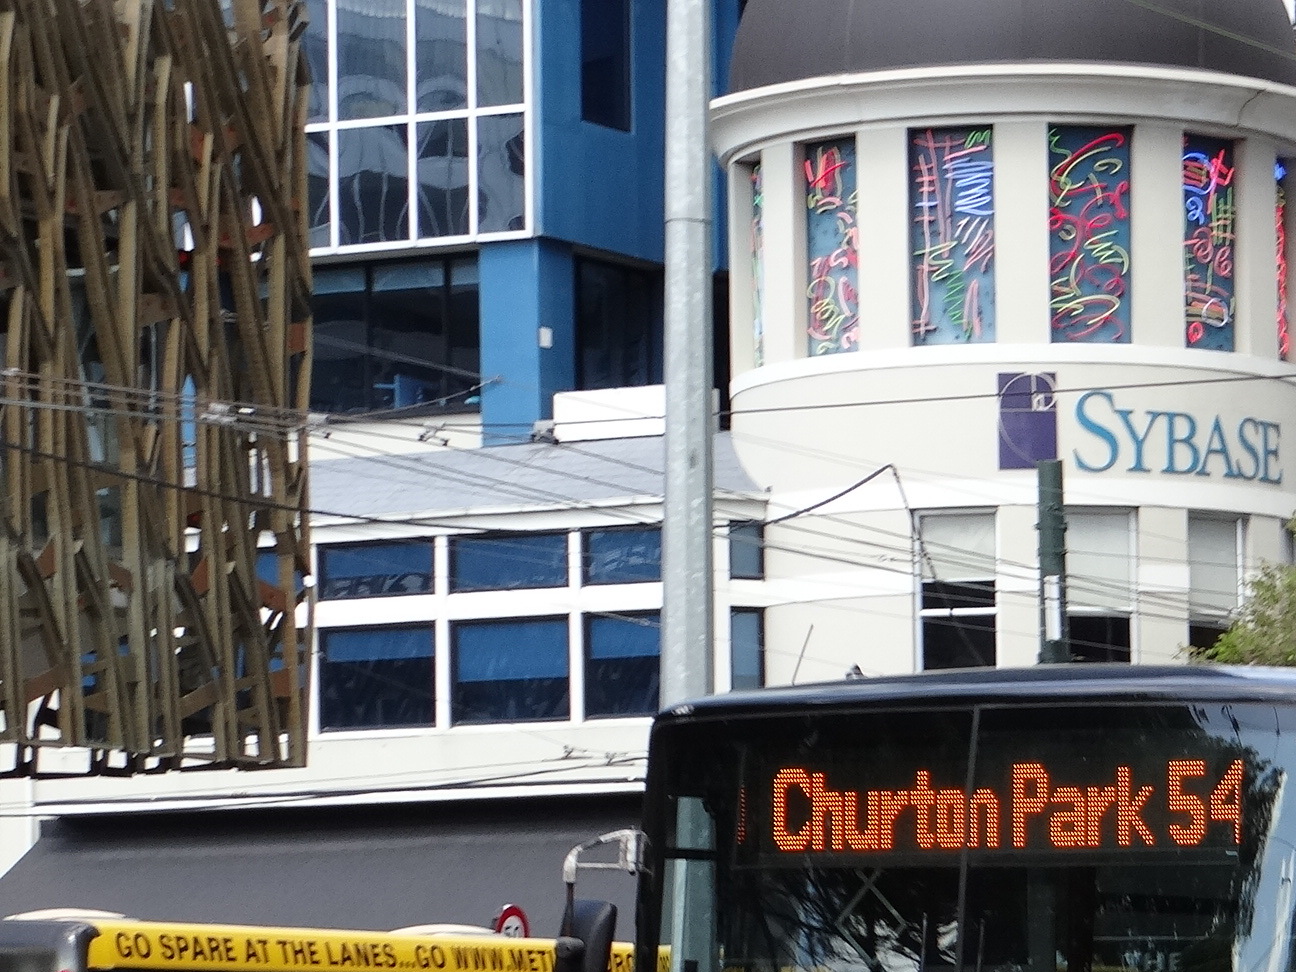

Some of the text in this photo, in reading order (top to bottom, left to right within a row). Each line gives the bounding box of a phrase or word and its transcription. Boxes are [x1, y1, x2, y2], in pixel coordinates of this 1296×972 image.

[1072, 388, 1283, 485] SYBASE
[772, 758, 1244, 851] Churton Park 54
[115, 932, 151, 960] GO
[158, 934, 237, 962] SPARE
[245, 939, 269, 964] AT
[276, 940, 320, 965] THE
